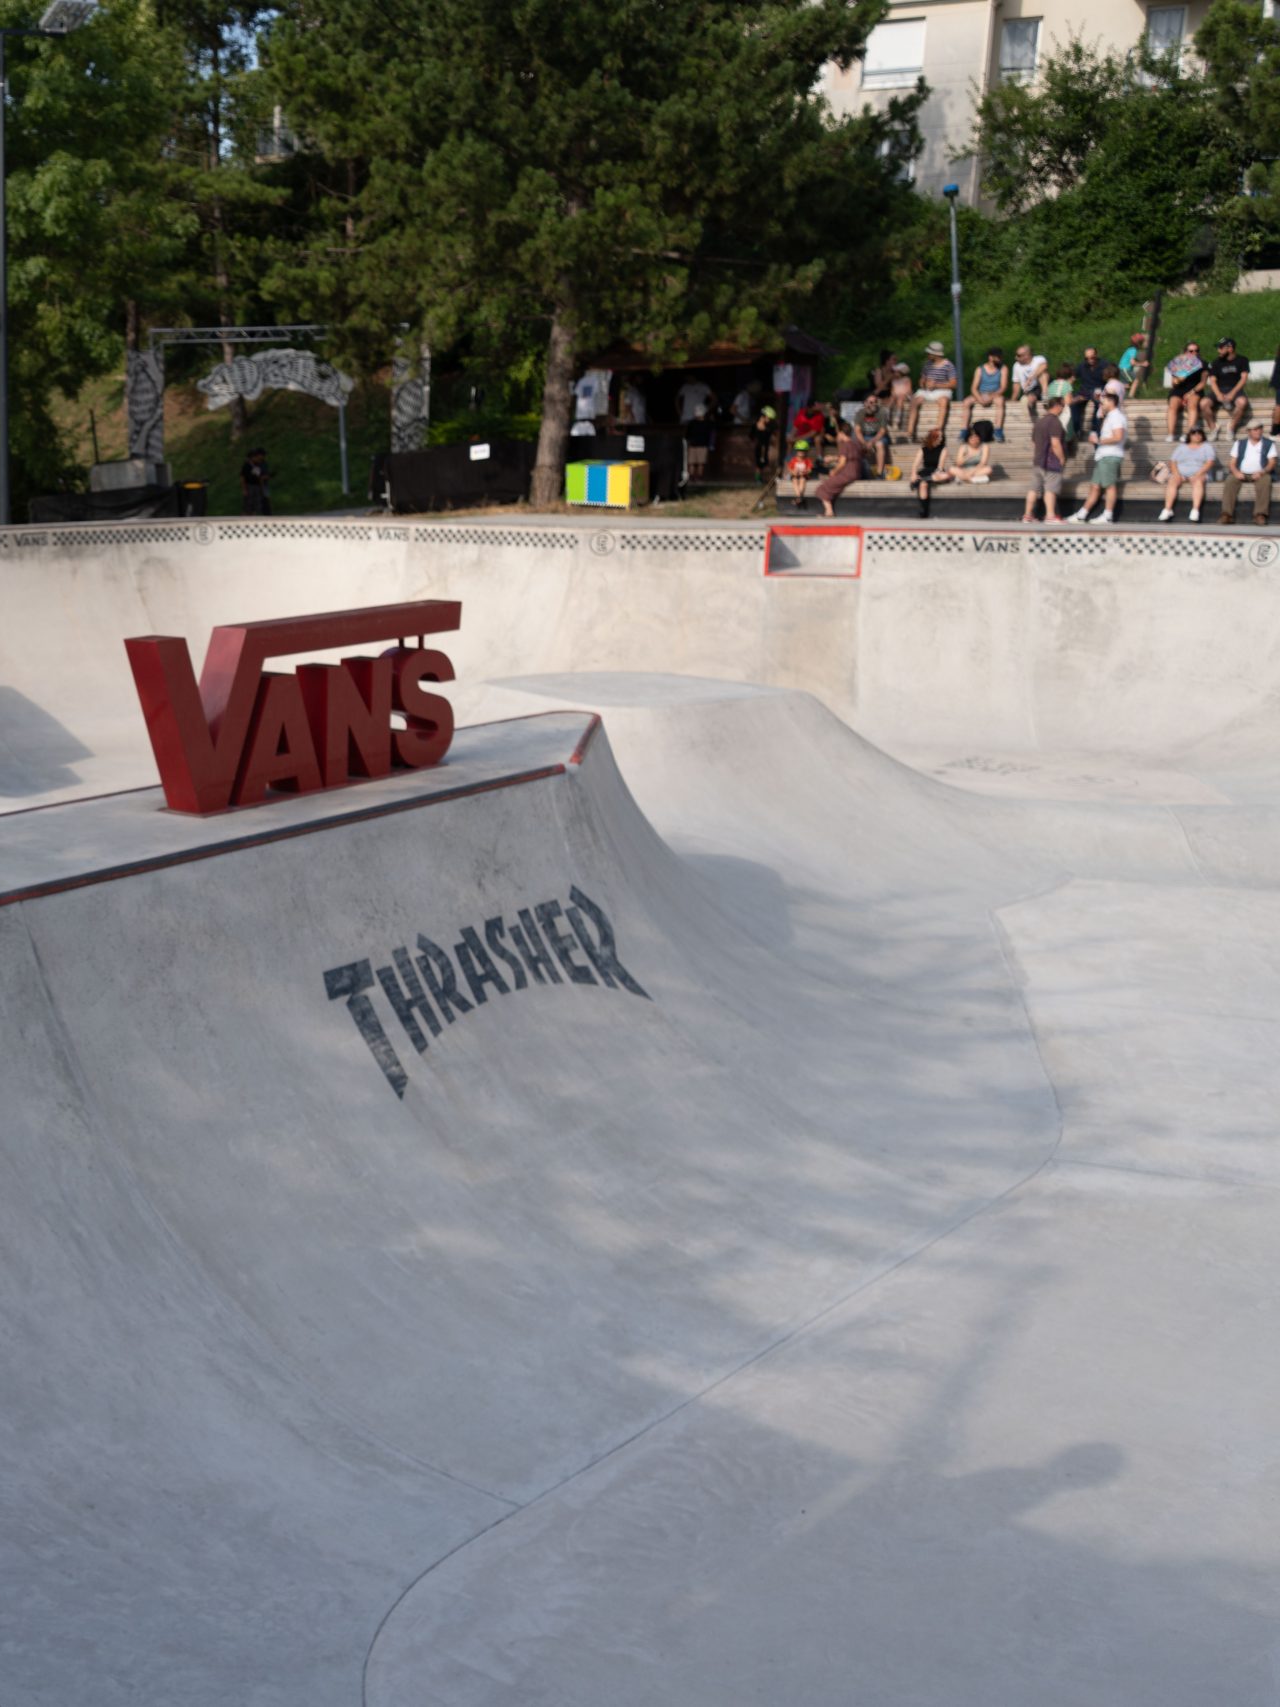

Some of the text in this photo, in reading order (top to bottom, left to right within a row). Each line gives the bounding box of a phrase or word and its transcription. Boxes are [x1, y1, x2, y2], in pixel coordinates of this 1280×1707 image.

[375, 526, 410, 541] VANS
[972, 536, 1021, 553] VANS
[124, 599, 462, 817] VANS
[322, 884, 653, 1100] THRASHER
